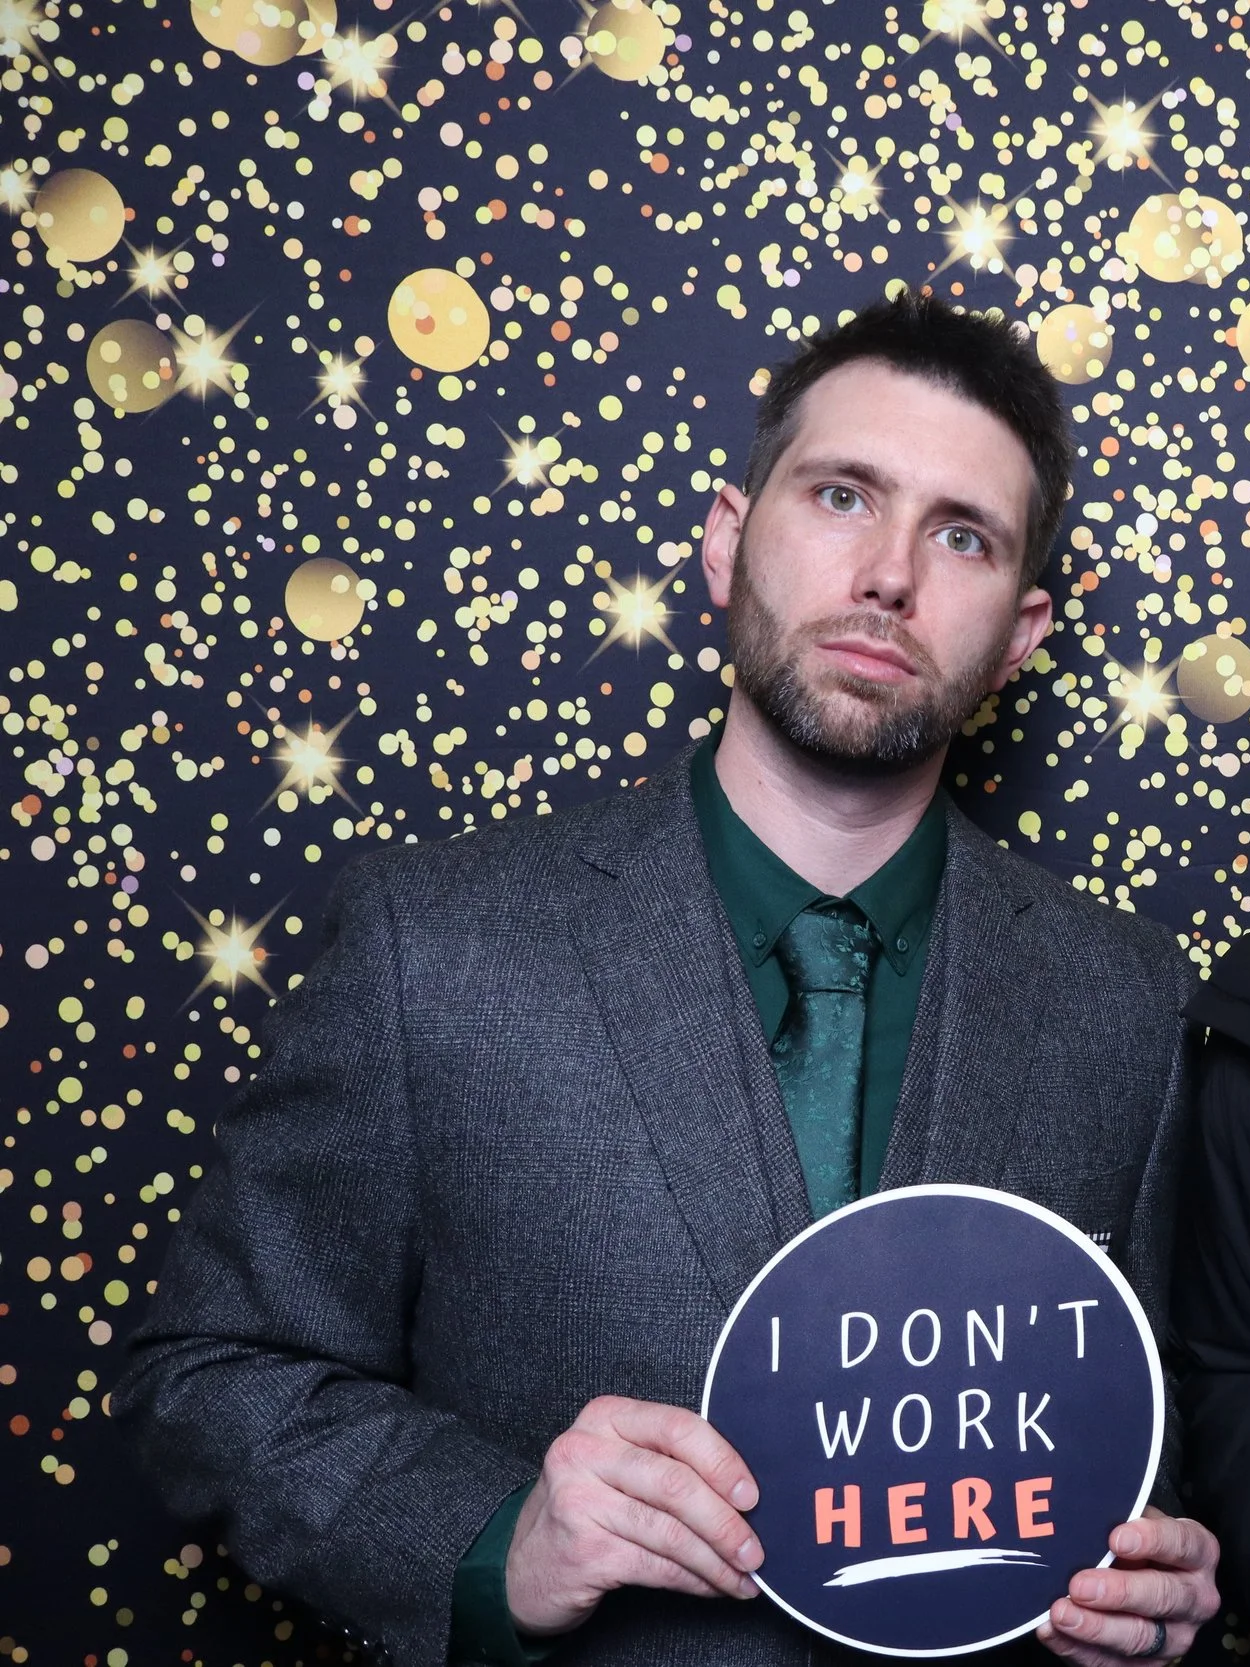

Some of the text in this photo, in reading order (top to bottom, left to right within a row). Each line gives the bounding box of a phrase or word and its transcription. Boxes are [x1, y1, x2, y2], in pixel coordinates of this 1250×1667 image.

[771, 1299, 1099, 1372] I DON'T
[815, 1388, 1055, 1459] WORK
[814, 1476, 1054, 1548] HERE
